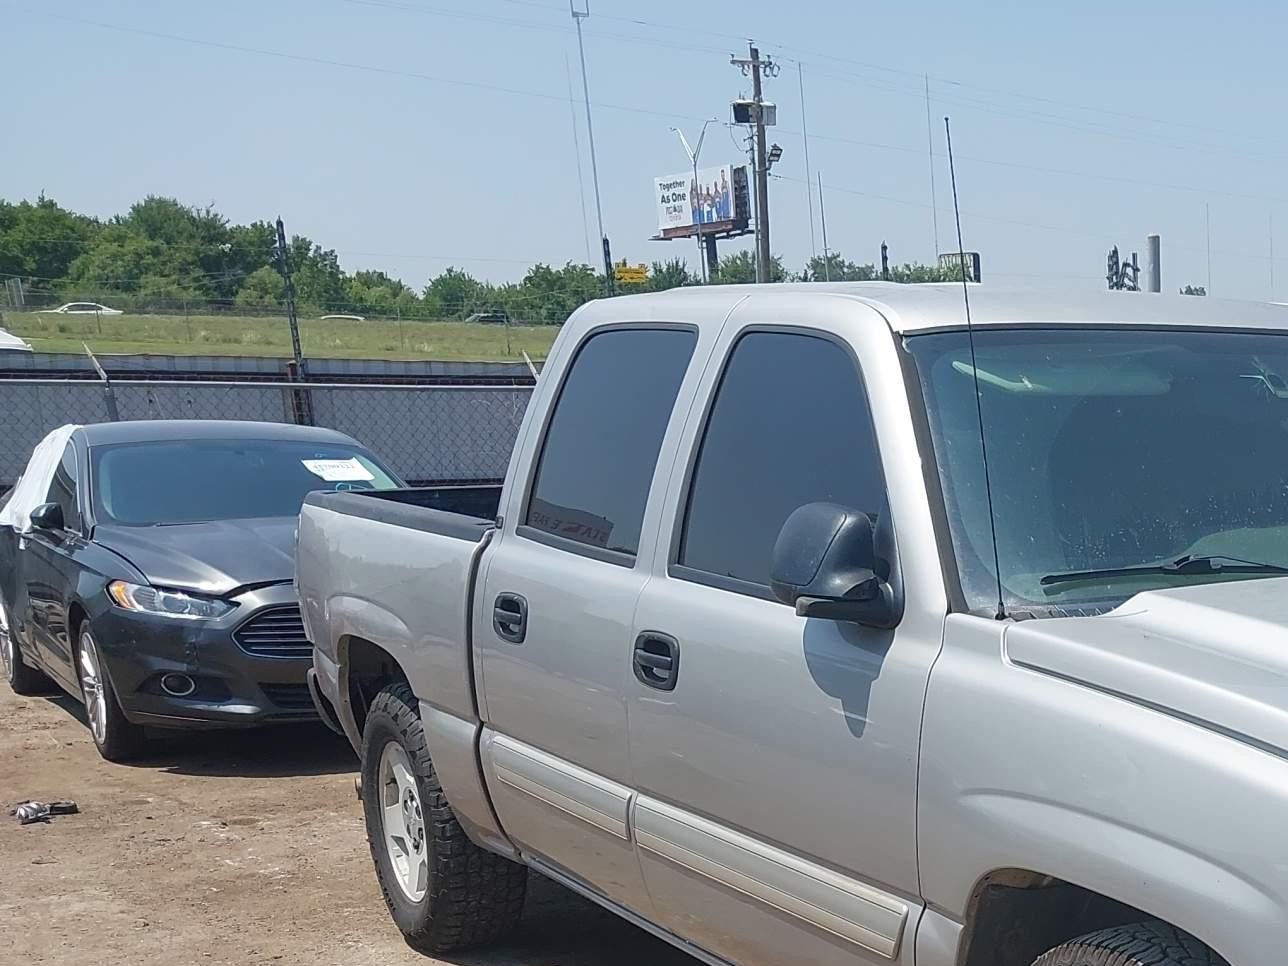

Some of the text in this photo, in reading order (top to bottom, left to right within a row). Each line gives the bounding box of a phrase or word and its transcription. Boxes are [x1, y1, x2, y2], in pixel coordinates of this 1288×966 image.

[659, 181, 685, 191] Together
[661, 192, 686, 204] As One
